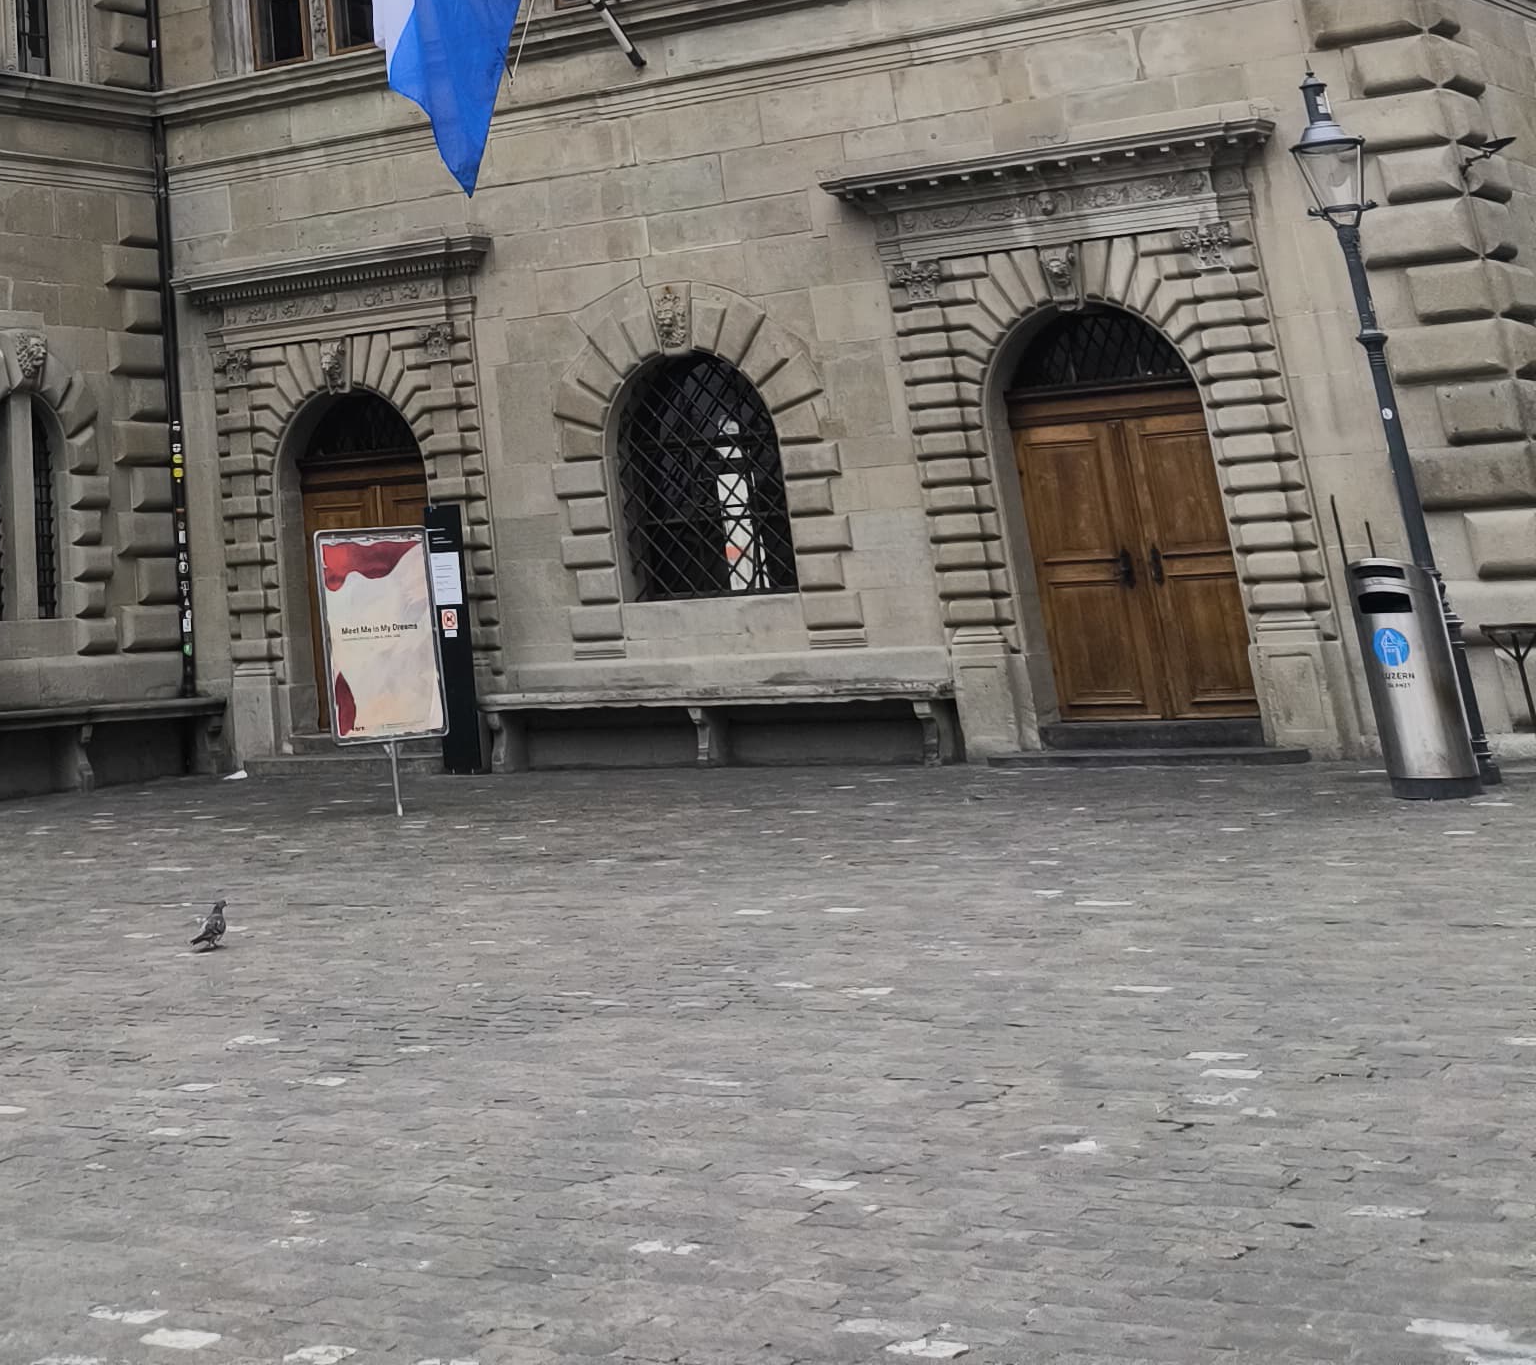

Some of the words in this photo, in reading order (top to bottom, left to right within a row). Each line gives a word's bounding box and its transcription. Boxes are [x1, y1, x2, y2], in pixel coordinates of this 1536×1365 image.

[341, 626, 359, 635] Meet
[360, 625, 372, 633] Me
[380, 623, 391, 633] My
[392, 623, 418, 631] Dreams
